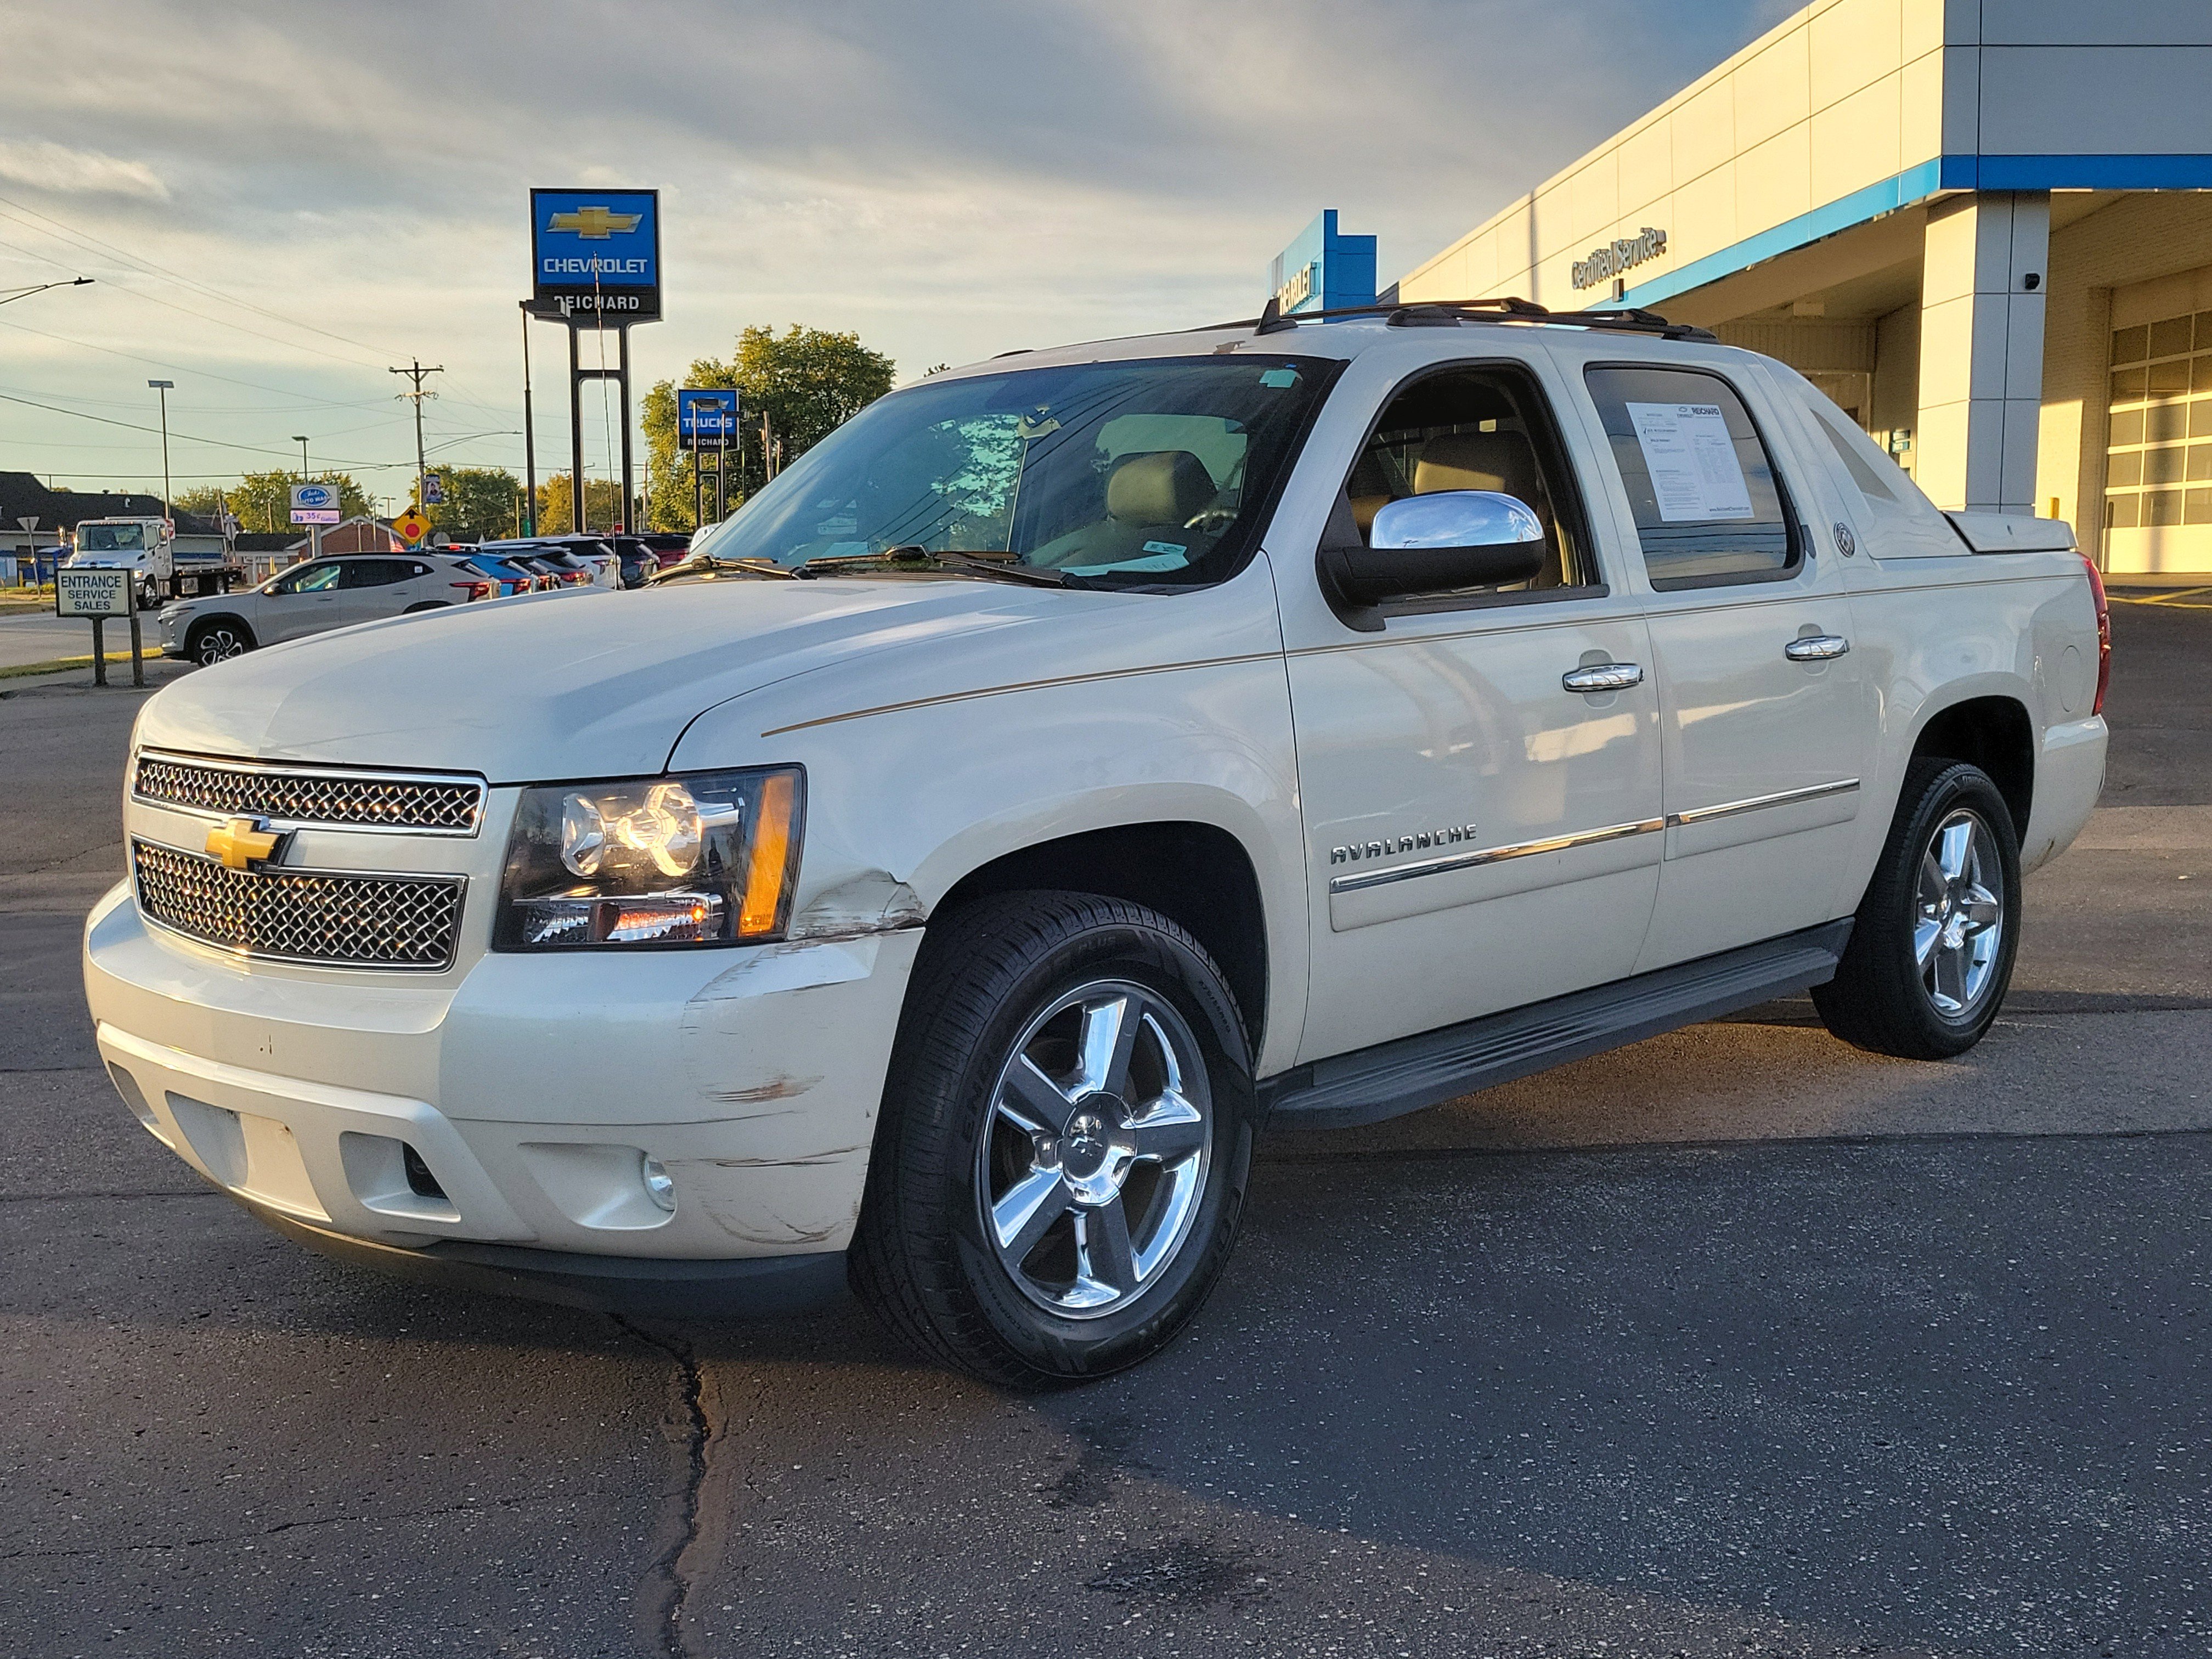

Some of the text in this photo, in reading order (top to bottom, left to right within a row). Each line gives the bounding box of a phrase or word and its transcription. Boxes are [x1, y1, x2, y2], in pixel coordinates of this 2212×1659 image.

[544, 258, 648, 273] CHEVROLET
[1572, 227, 1664, 290] Certified Service
[1272, 262, 1312, 316] HEVROLET
[682, 417, 733, 428] TRUCKS
[61, 575, 122, 588] ENTRANCE
[68, 590, 116, 599] SERVICE
[74, 601, 111, 611] SALES
[1330, 823, 1477, 865] AVALANCHE
